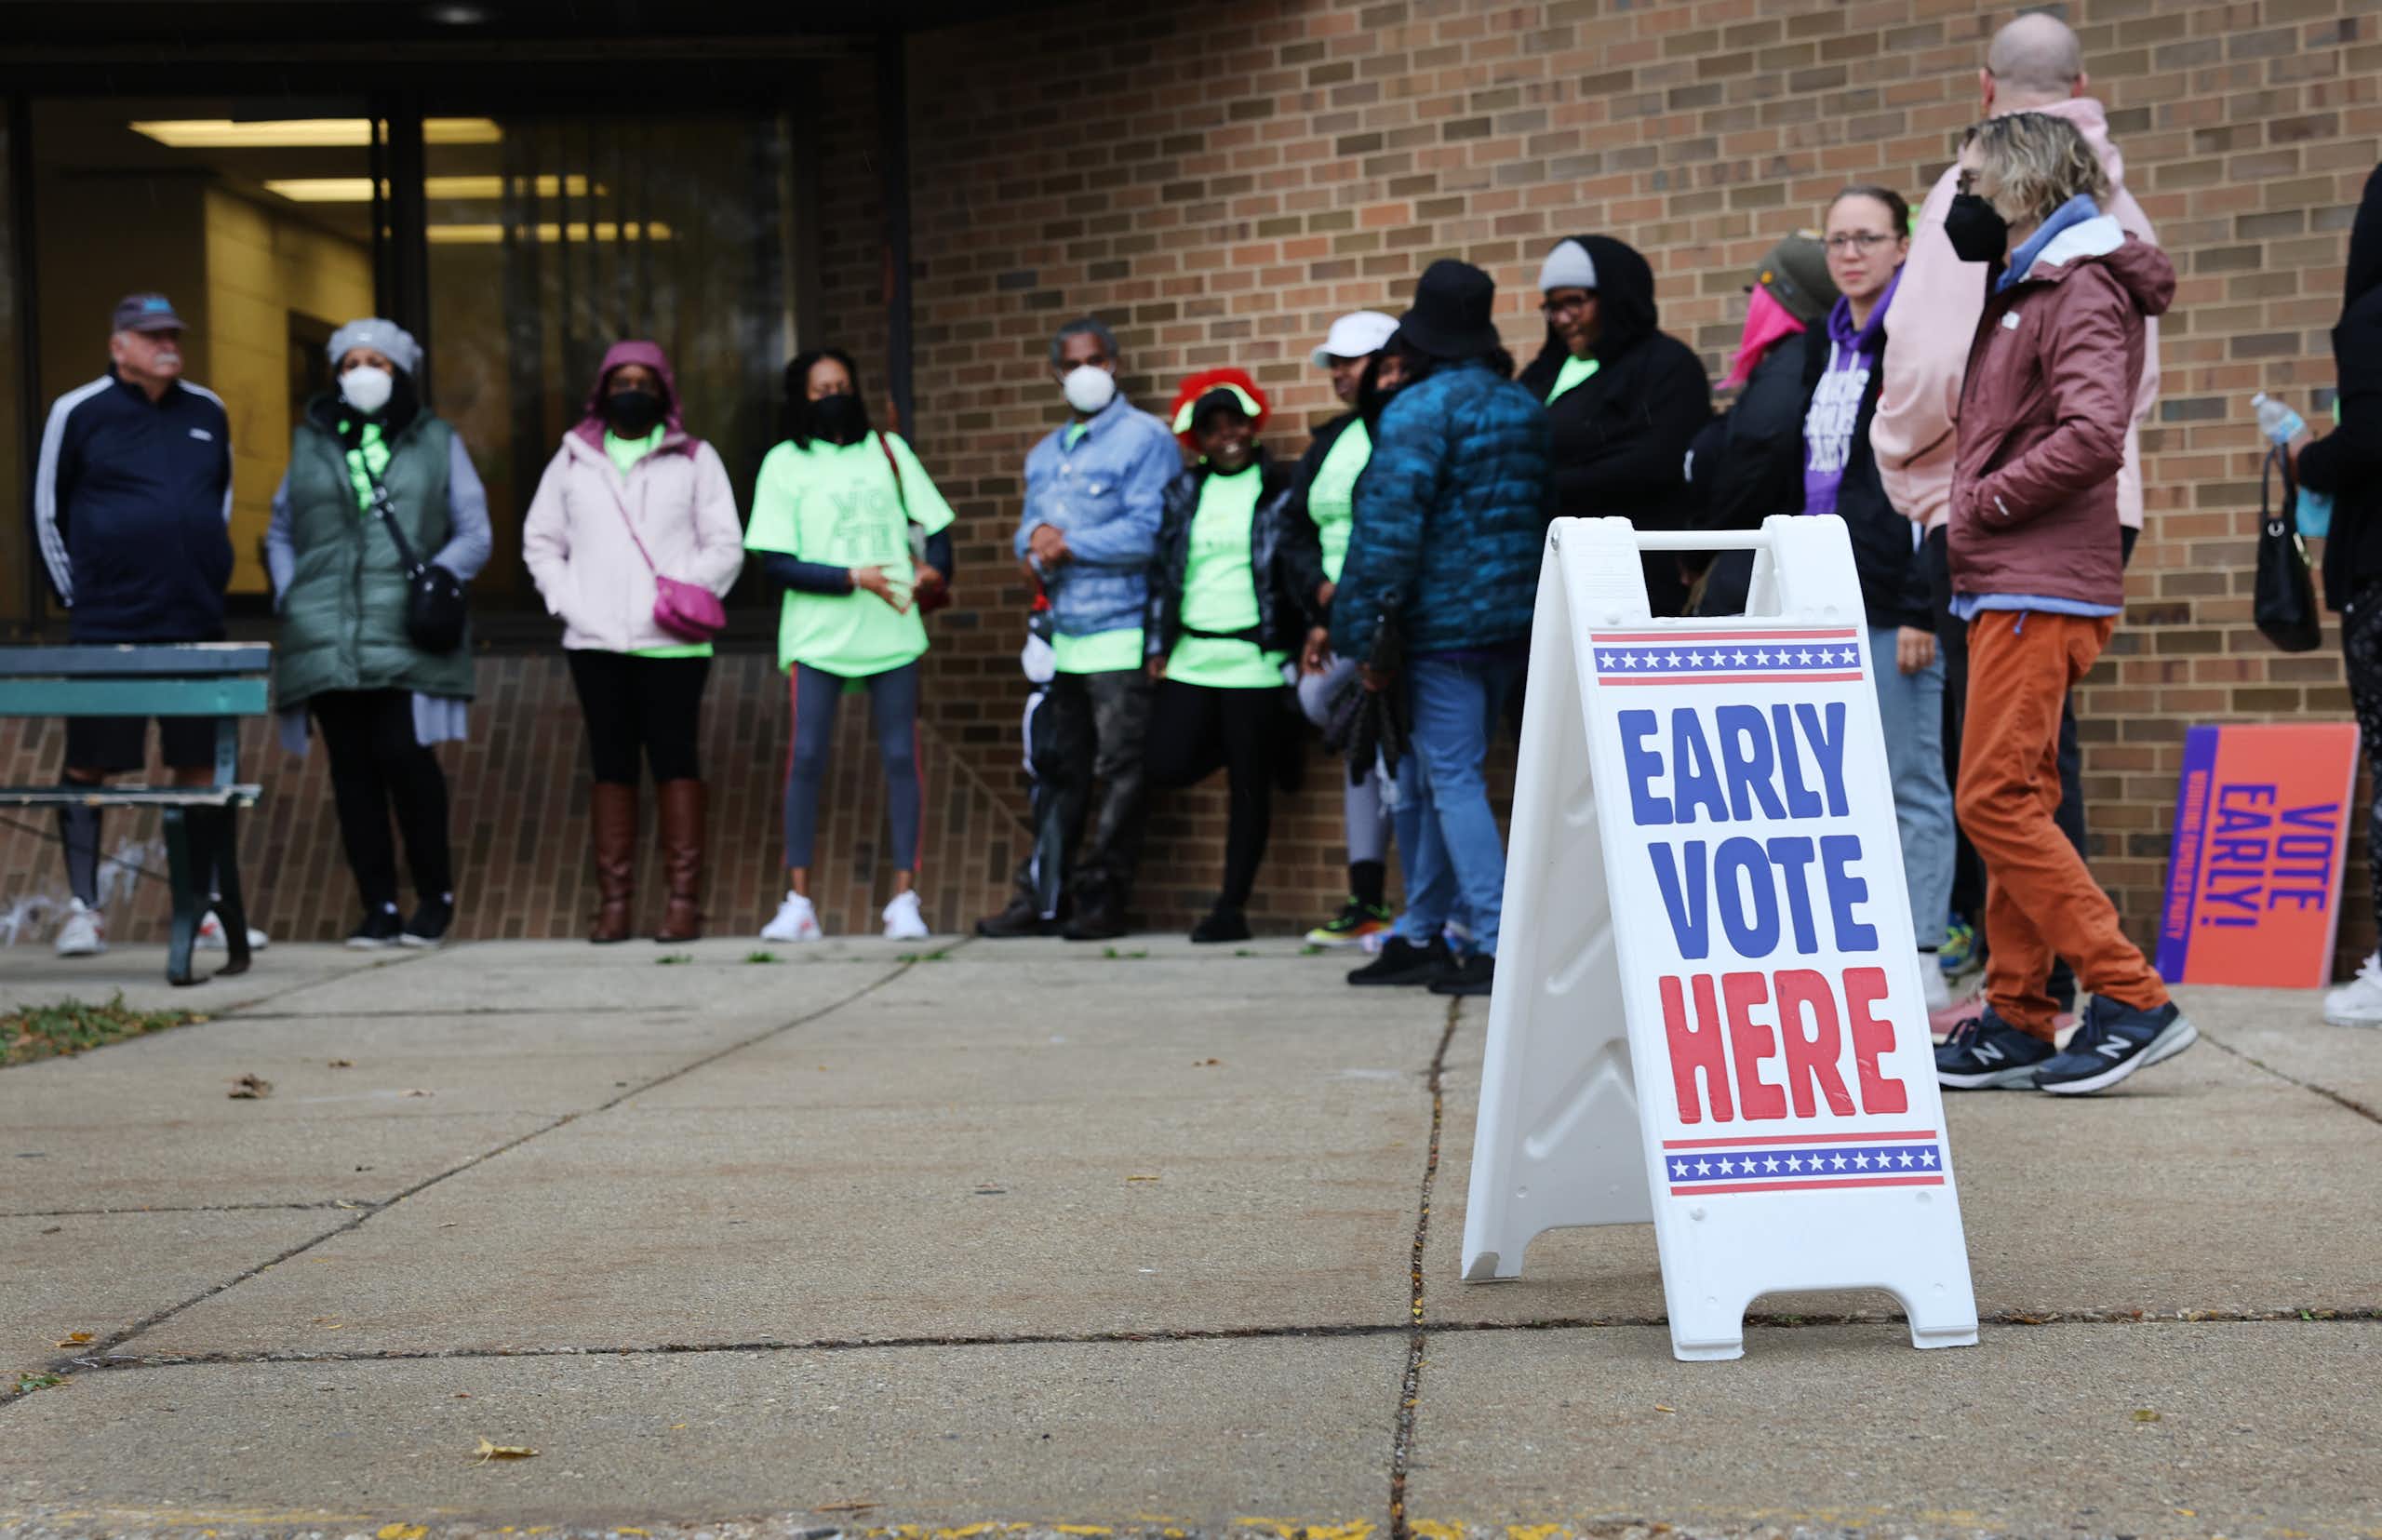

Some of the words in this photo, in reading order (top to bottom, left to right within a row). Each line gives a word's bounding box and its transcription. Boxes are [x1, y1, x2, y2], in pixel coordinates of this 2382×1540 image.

[1617, 702, 1850, 825] EARLY
[1647, 835, 1879, 959] VOTE
[2201, 783, 2277, 928] EARLY!
[2268, 802, 2339, 912] VOTE
[1659, 967, 1908, 1124] HERE
